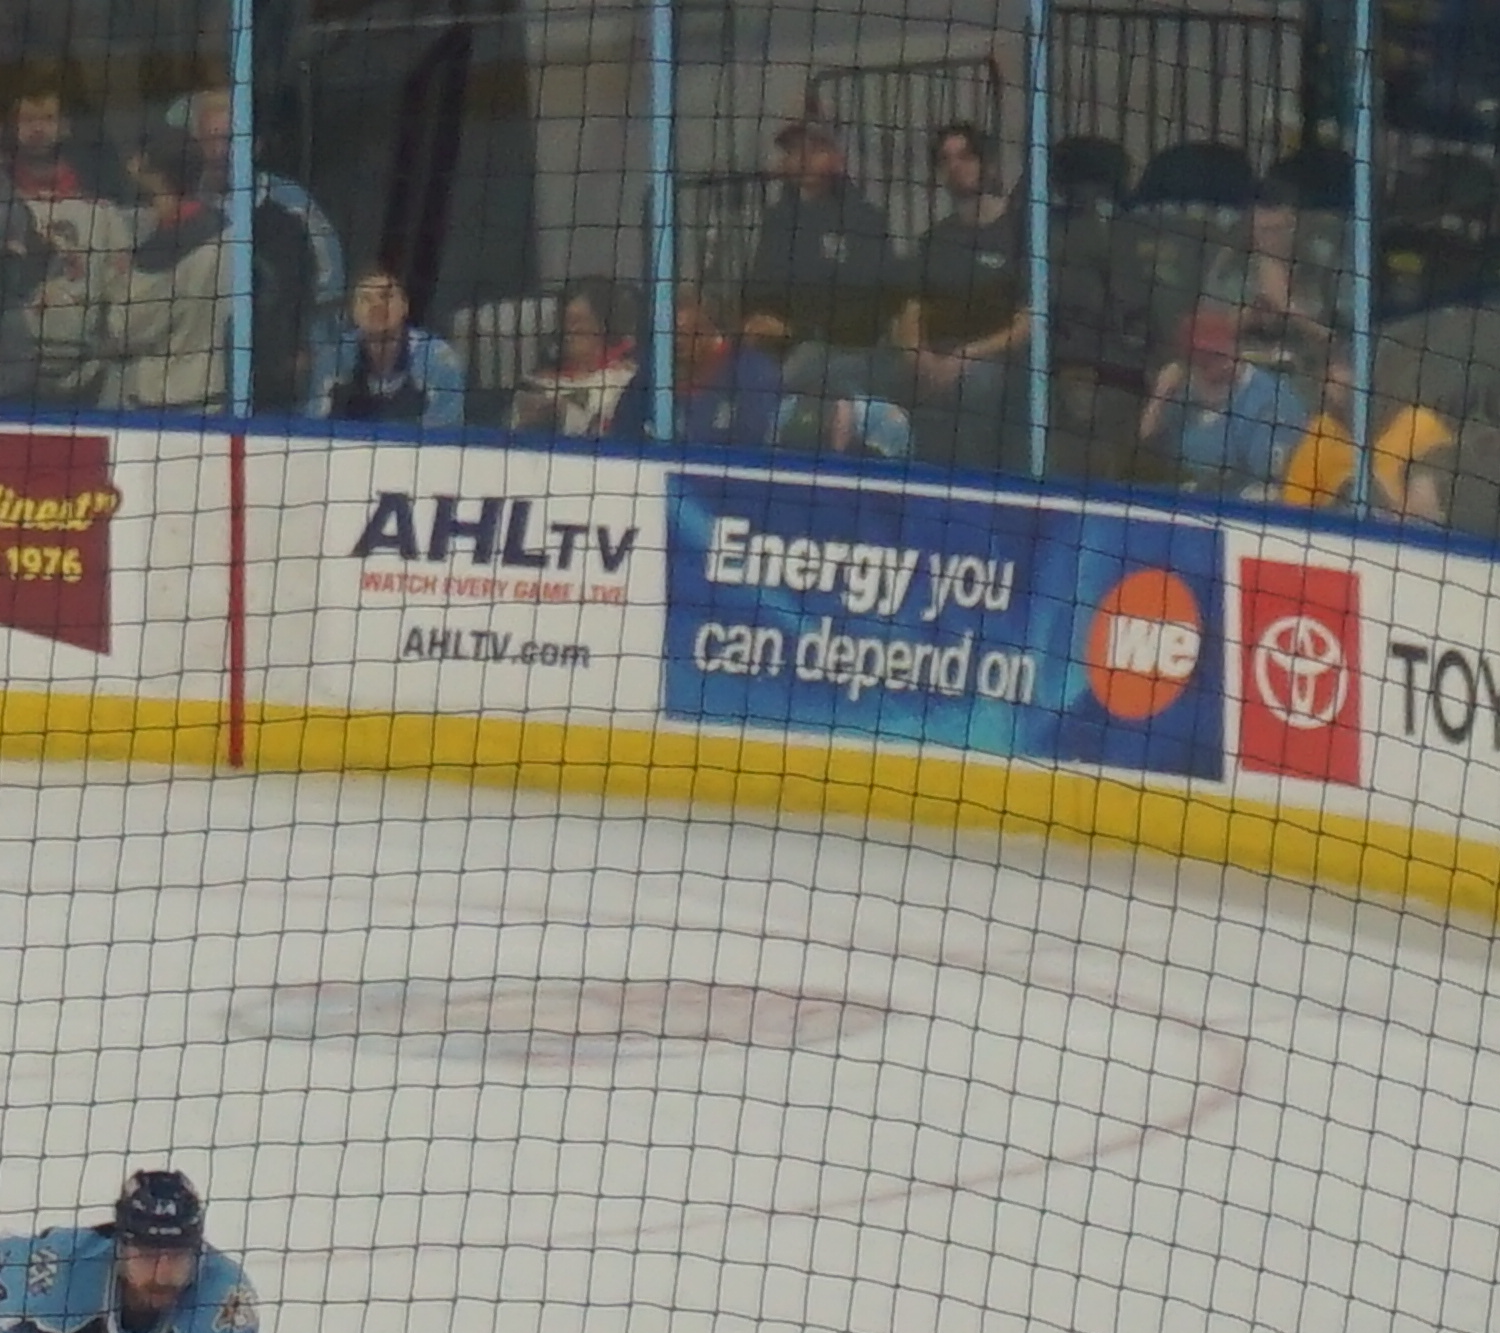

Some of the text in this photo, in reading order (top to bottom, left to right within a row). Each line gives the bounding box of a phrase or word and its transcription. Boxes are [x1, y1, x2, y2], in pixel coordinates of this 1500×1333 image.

[7, 546, 82, 582] 1976
[705, 516, 1014, 622] Energy you
[362, 572, 436, 596] WATCH
[514, 580, 573, 601] GAME
[402, 626, 590, 668] AHLTV.com
[695, 617, 1036, 702] can depend on
